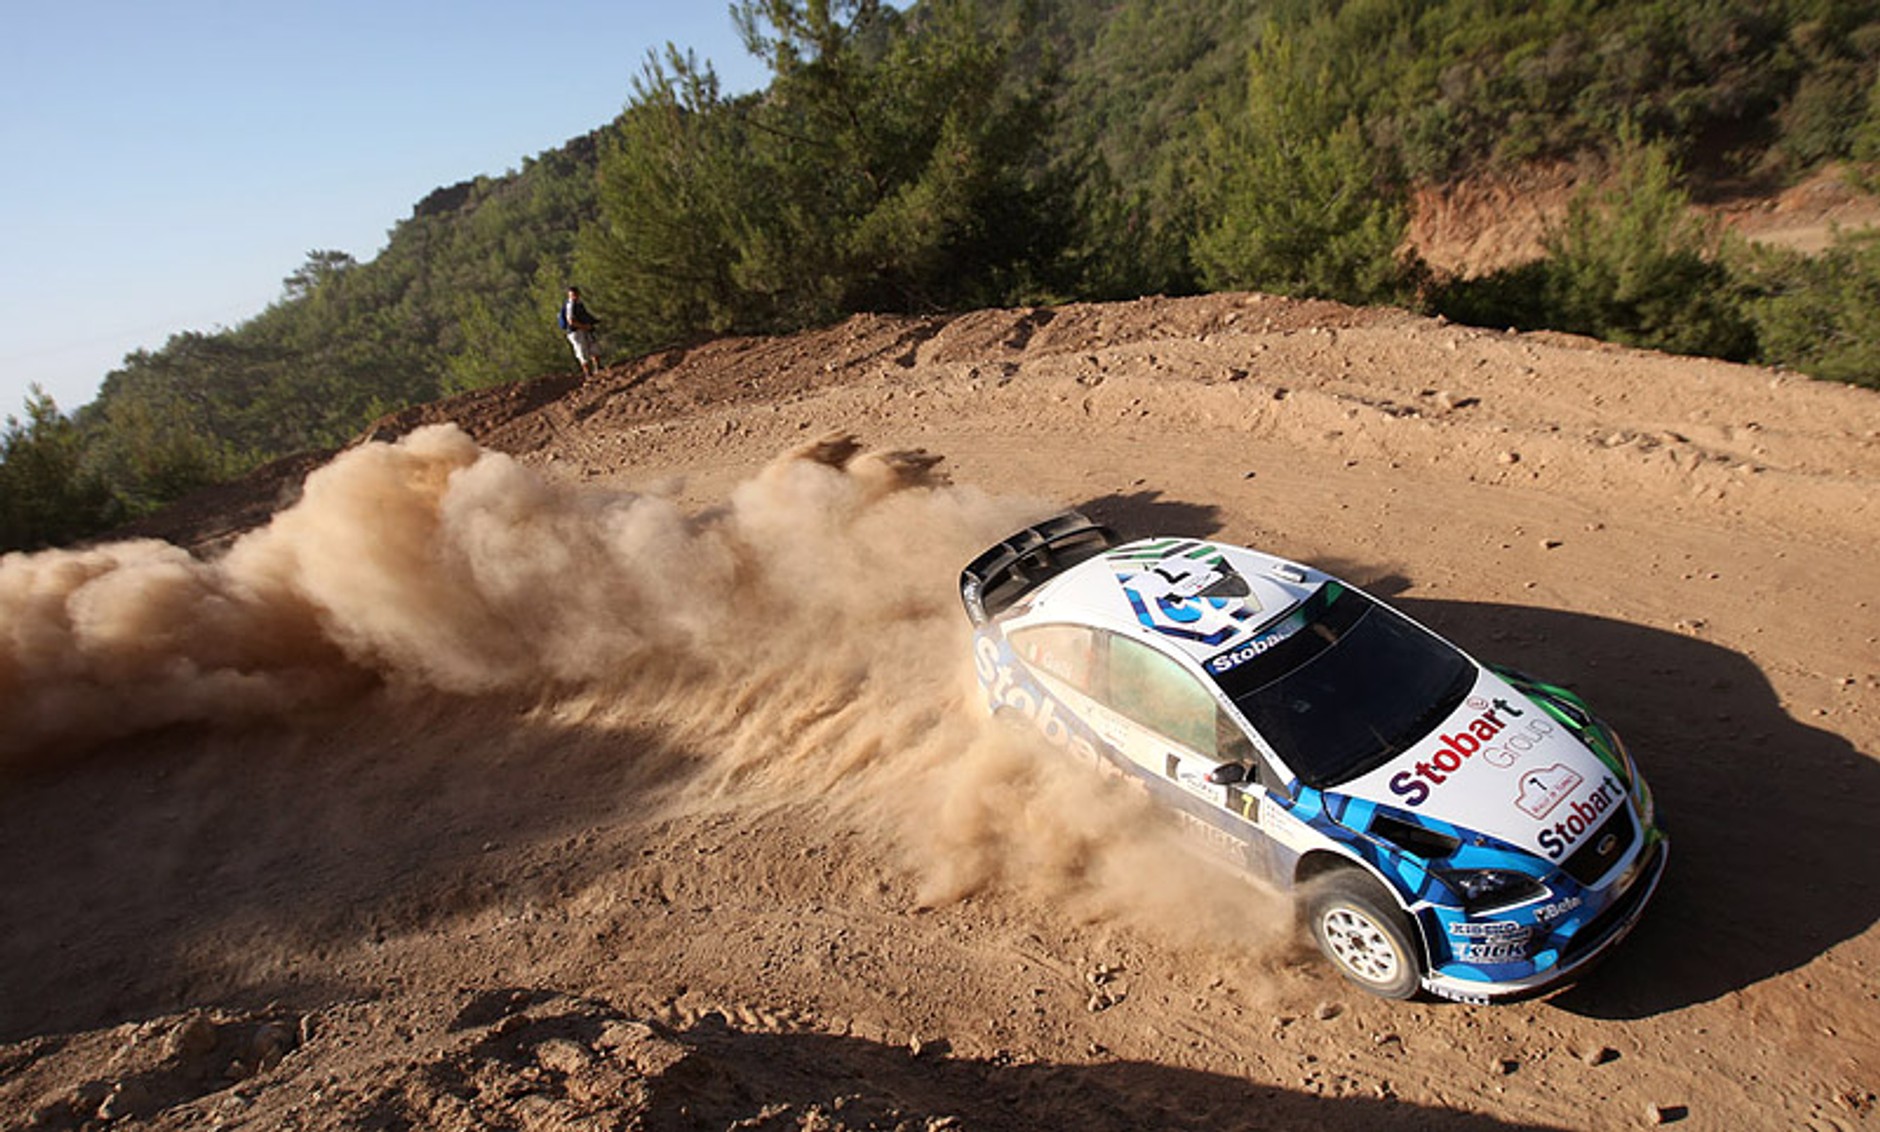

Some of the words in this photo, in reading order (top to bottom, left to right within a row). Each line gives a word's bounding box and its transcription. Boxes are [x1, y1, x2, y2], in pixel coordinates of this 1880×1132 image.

[1212, 627, 1292, 672] Stoba
[971, 635, 1146, 798] Stoba
[1482, 718, 1554, 769] Group
[1388, 698, 1524, 807] Stobart
[1240, 793, 1255, 819] 7
[1537, 775, 1623, 859] Stobart
